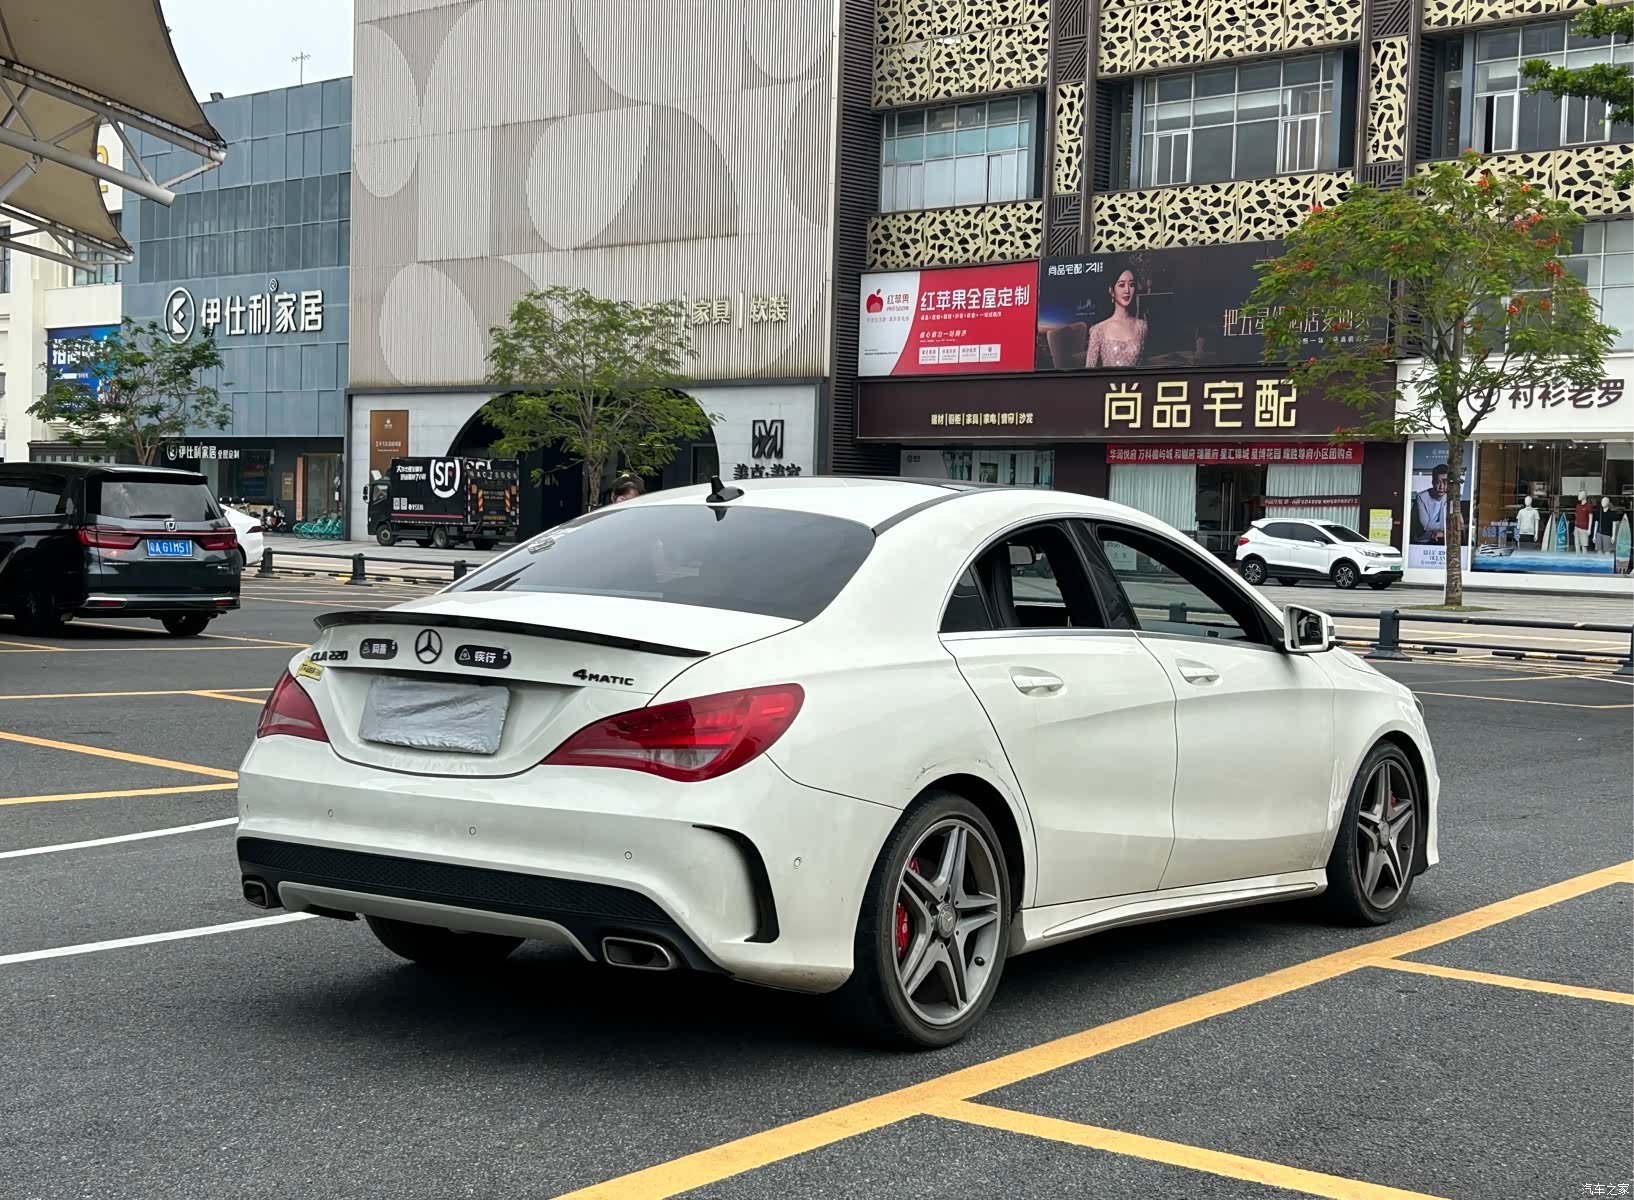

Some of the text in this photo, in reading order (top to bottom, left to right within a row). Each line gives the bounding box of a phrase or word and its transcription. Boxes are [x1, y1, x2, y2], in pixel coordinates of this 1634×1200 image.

[1048, 263, 1083, 276] 尚品宅配
[920, 284, 1030, 312] 红苹果全屋定制
[200, 289, 324, 337] 伊仕利家居
[692, 299, 731, 325] 家具
[1104, 379, 1297, 428] 尚品宅配
[1508, 378, 1625, 409] 衬衫老罗
[178, 445, 217, 459] 伊仕利家居
[311, 650, 348, 661] CLA 220
[474, 651, 497, 664] 疾行
[572, 668, 635, 686] 4MATIC
